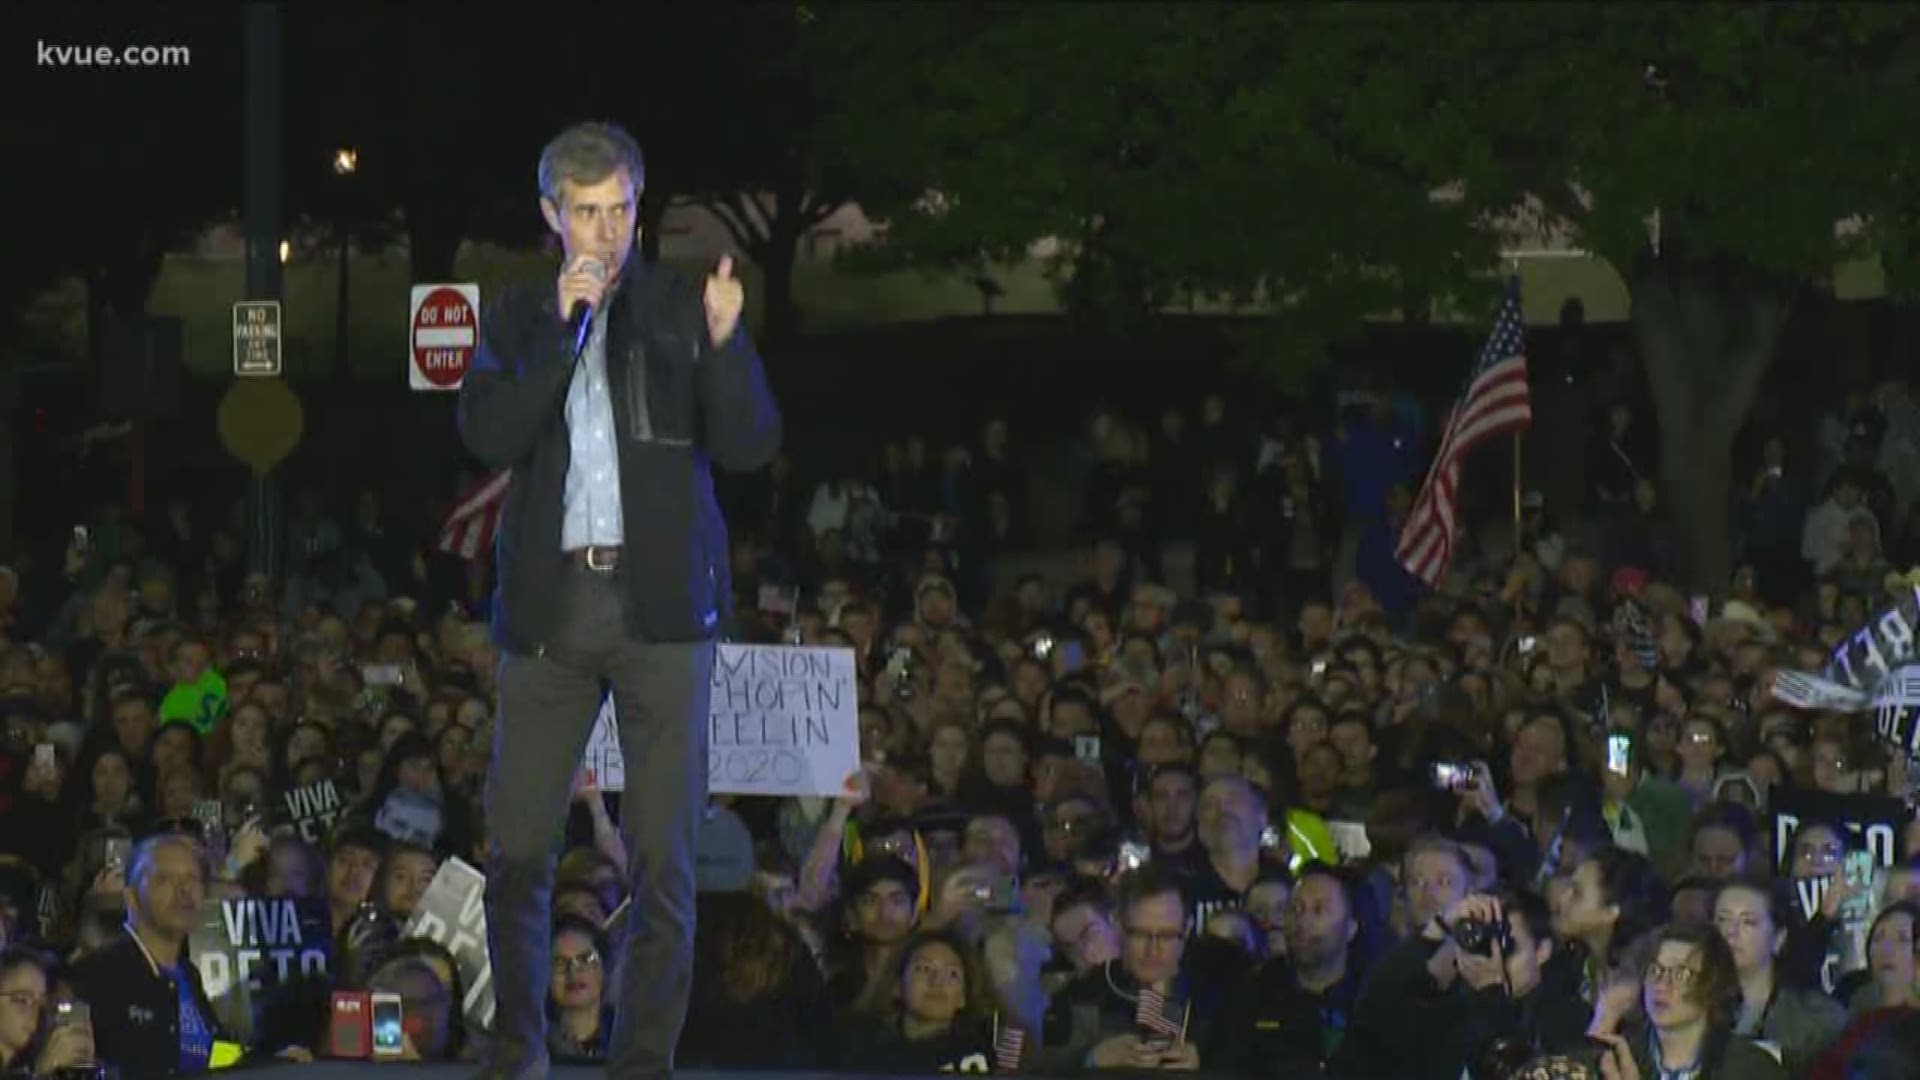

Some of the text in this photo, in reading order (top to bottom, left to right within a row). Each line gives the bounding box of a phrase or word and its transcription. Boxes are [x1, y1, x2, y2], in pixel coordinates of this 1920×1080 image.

[247, 309, 266, 323] NO
[421, 304, 468, 324] DO NOT
[426, 348, 463, 370] ENTER
[284, 778, 340, 821] VIVA
[221, 898, 303, 947] VIVA
